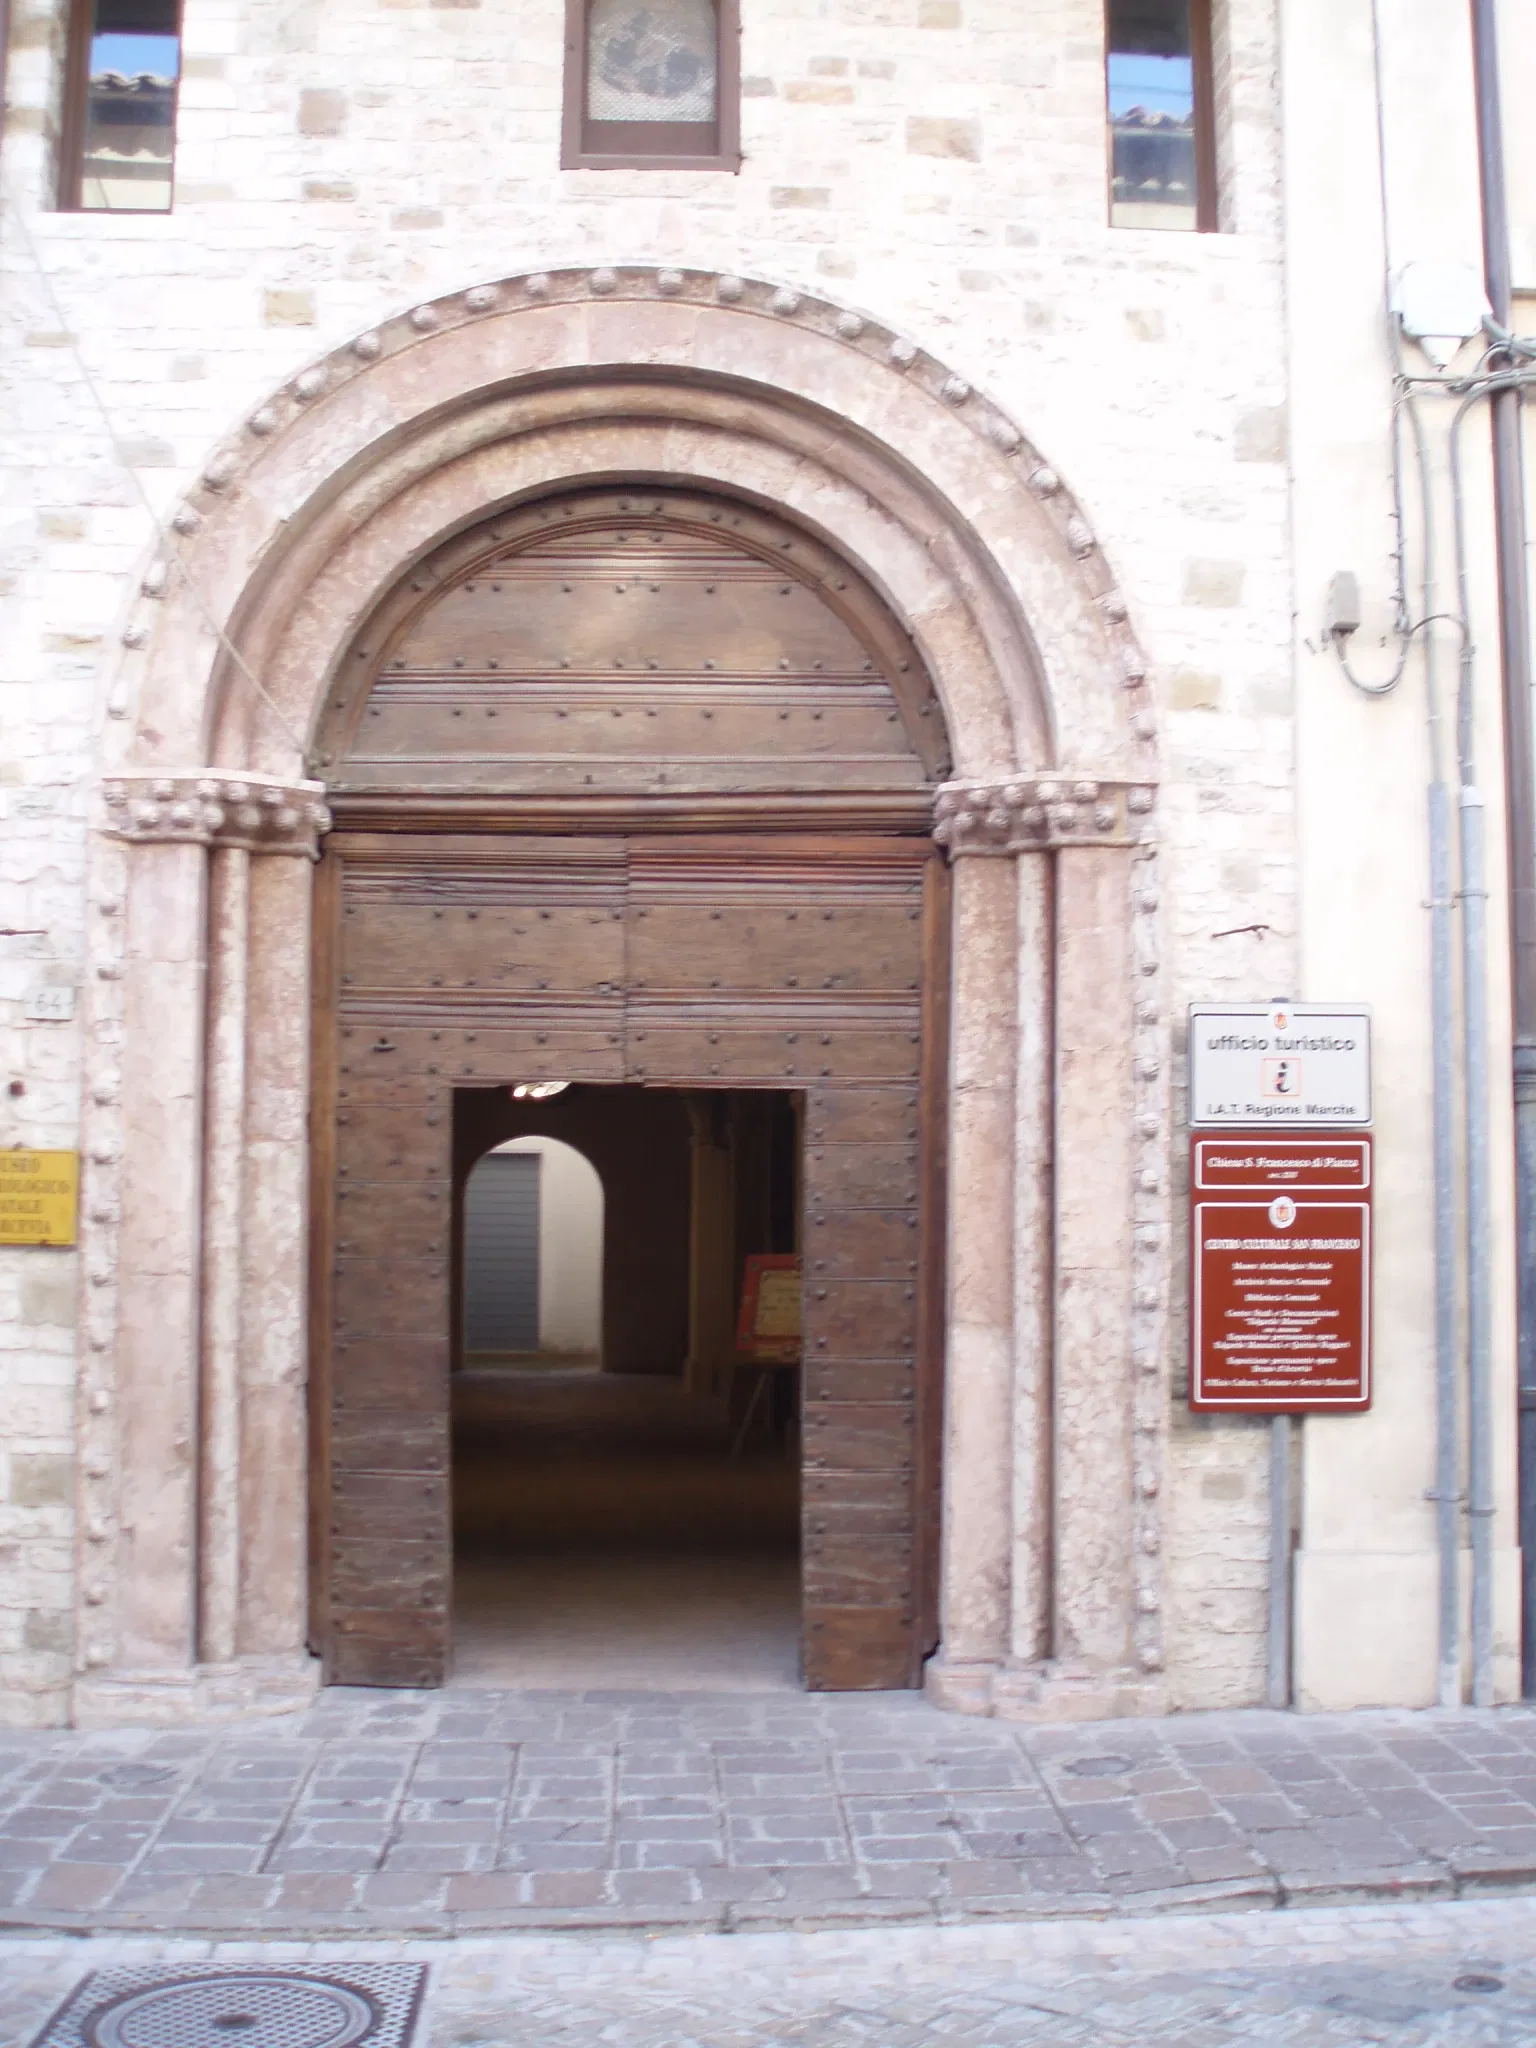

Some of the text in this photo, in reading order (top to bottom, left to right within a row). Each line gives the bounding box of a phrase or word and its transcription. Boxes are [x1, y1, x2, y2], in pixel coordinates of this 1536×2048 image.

[1207, 1036, 1356, 1051] ufficio turistico
[1244, 1104, 1302, 1118] Regione
[1305, 1104, 1357, 1115] Marche
